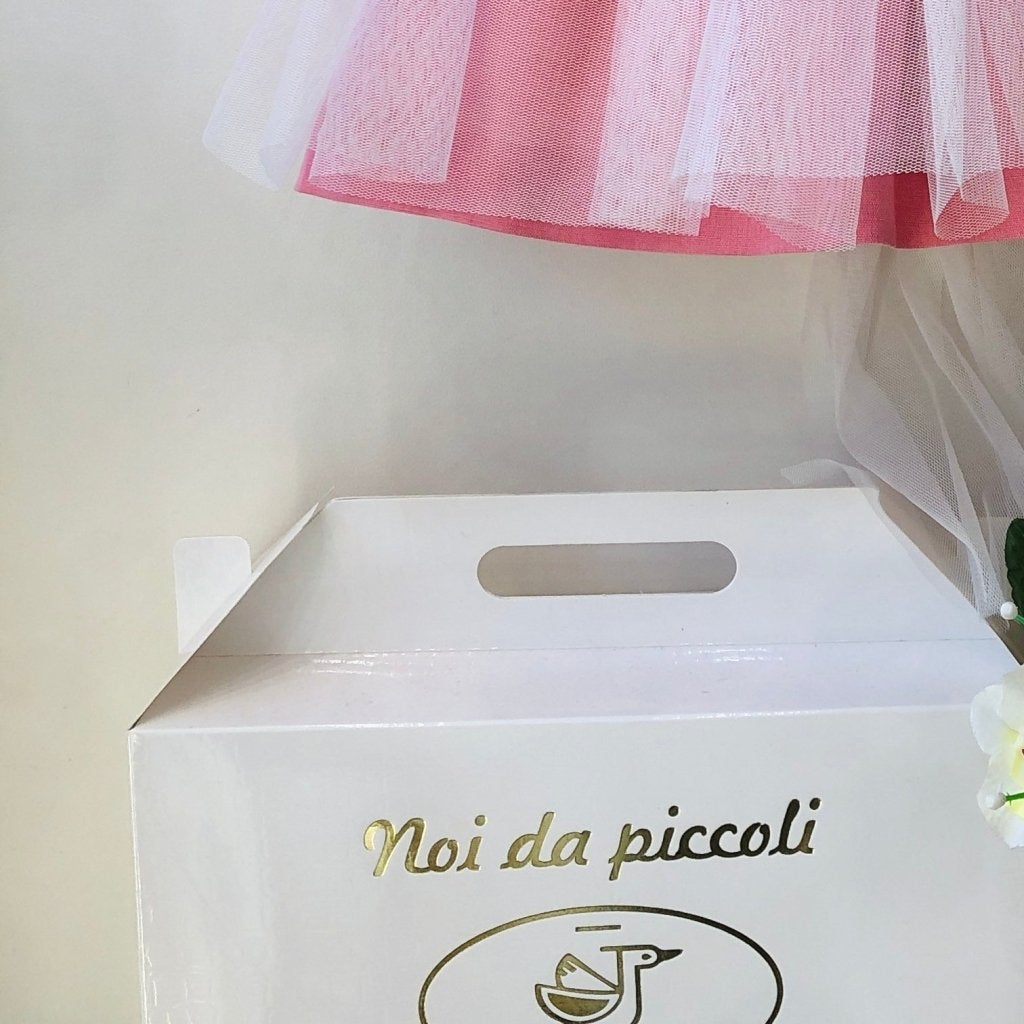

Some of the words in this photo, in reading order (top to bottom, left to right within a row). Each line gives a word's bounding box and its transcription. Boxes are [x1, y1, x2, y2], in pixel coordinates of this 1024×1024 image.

[363, 814, 488, 878] Noi
[499, 811, 592, 869] da
[607, 796, 822, 882] piccoli
